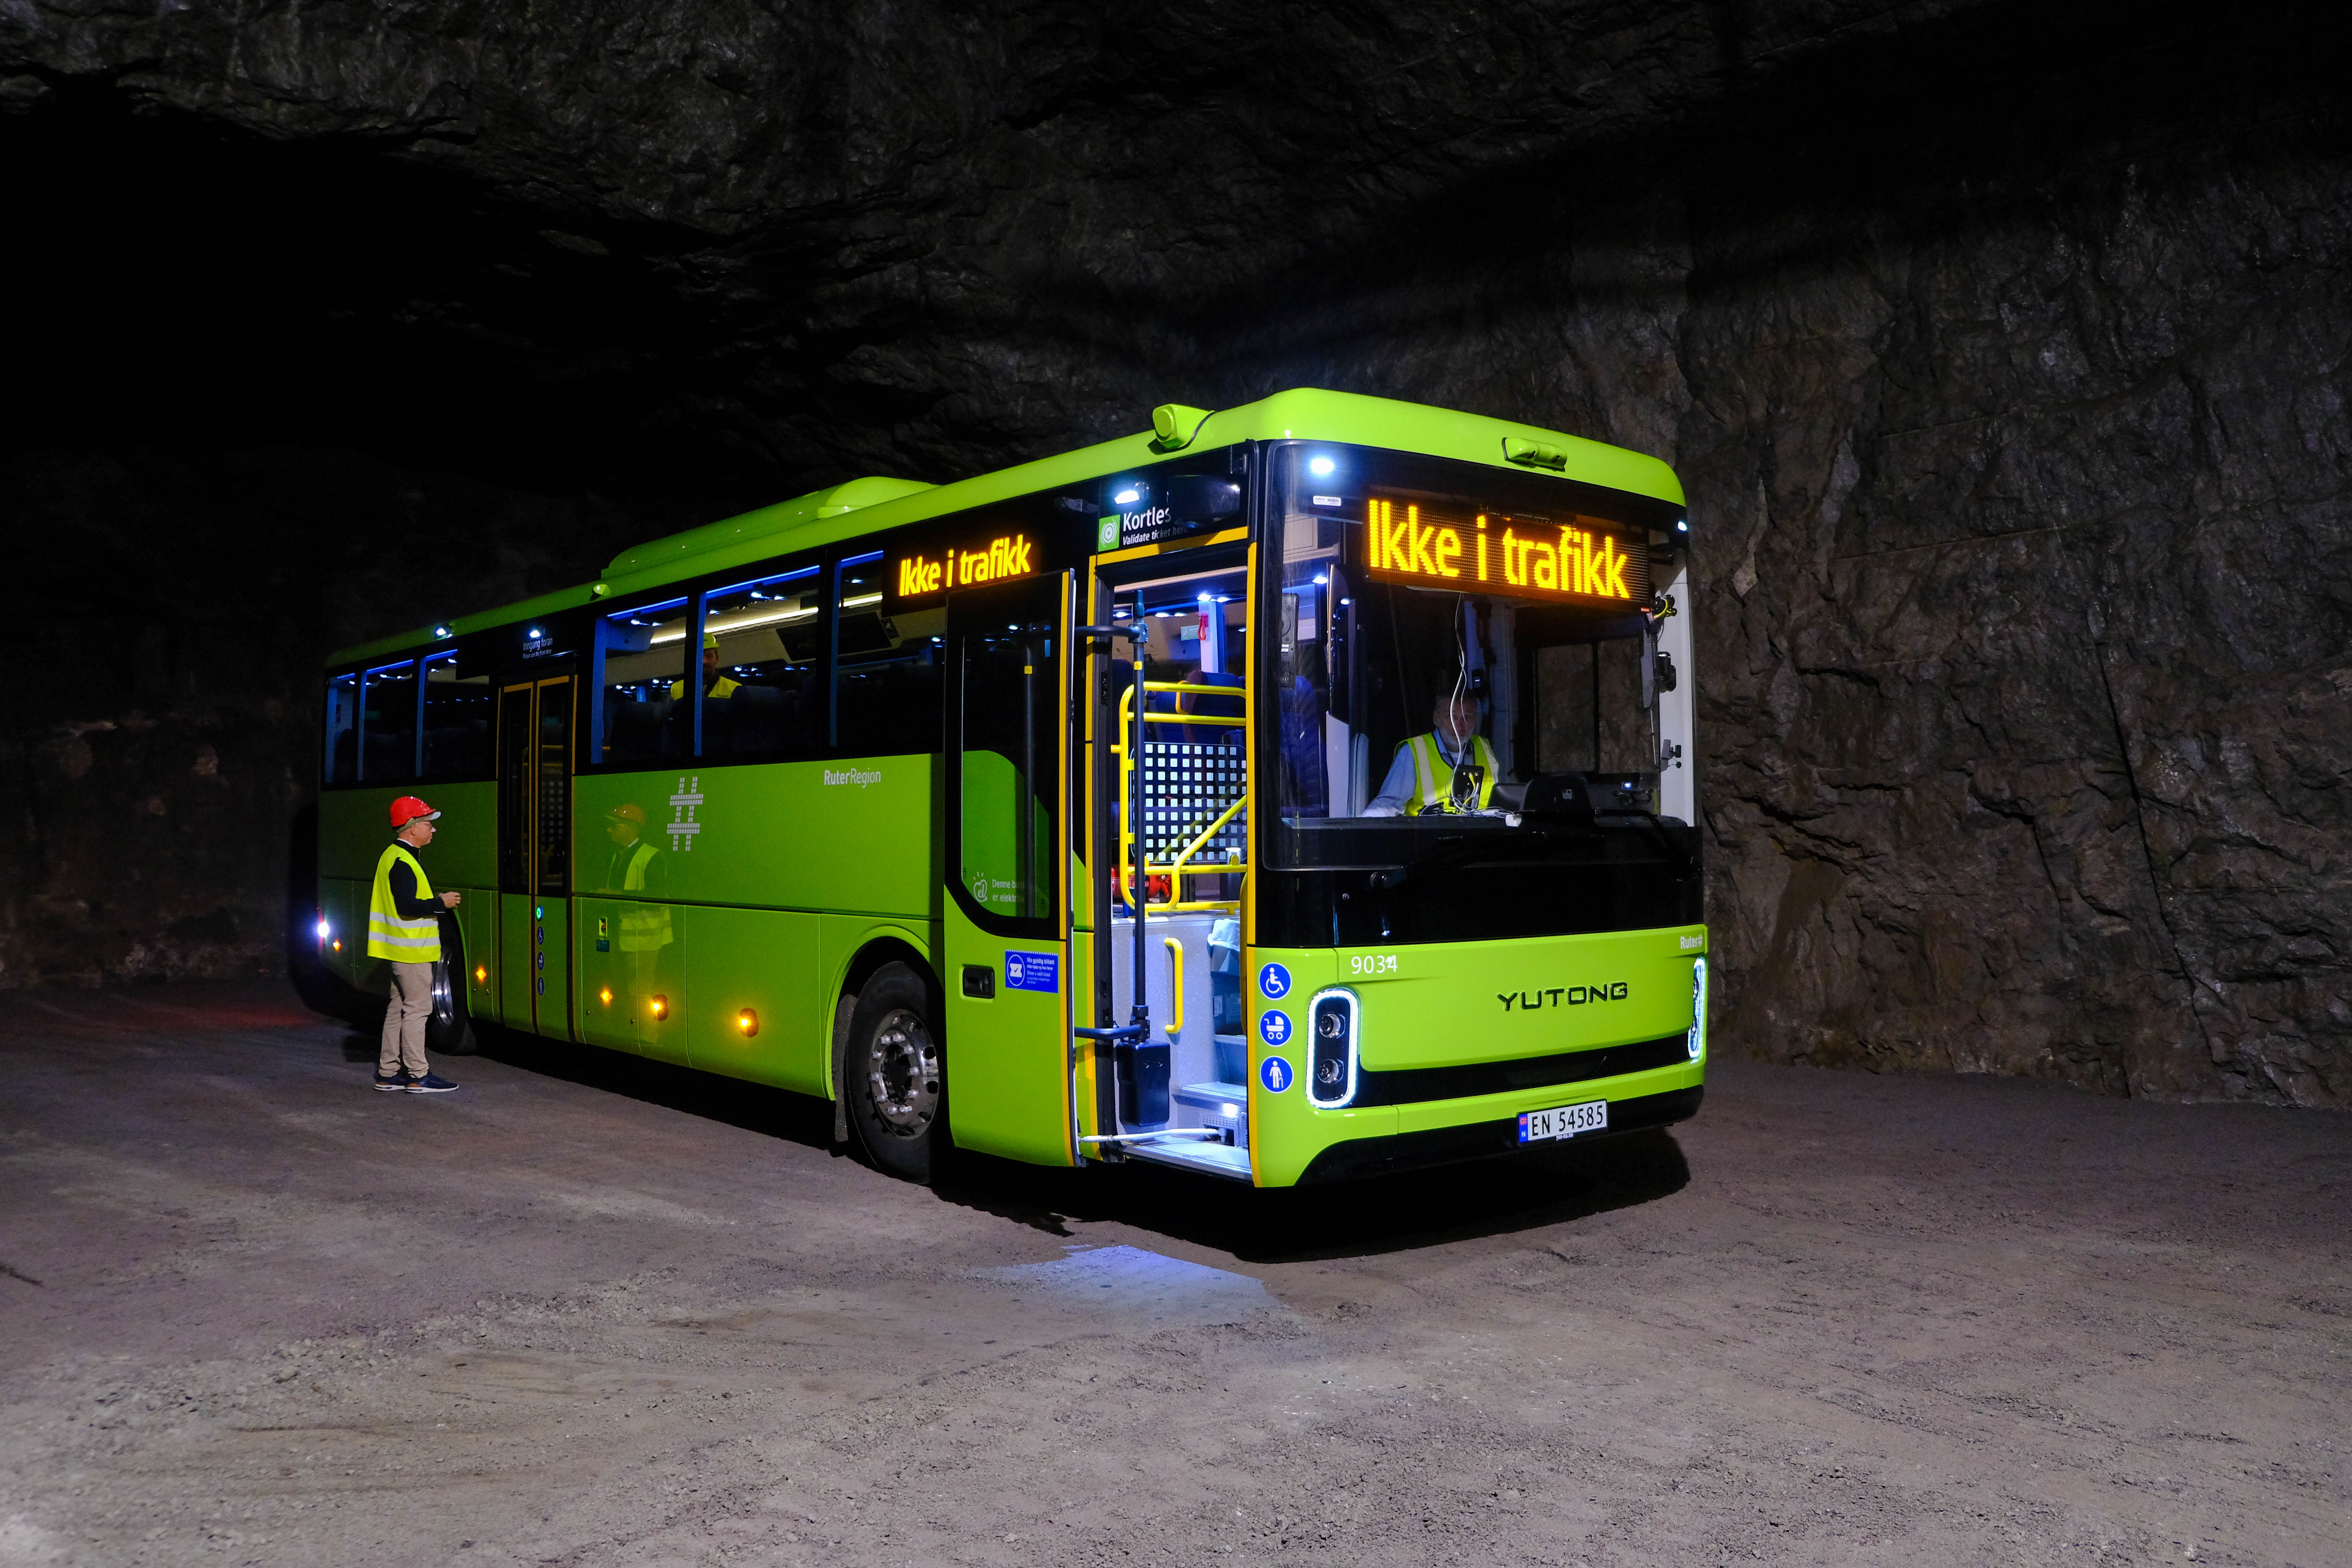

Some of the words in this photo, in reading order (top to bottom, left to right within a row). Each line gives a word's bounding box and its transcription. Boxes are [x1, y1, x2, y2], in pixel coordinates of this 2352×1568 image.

[1123, 507, 1171, 532] Kortles
[1123, 533, 1150, 546] Validate
[1152, 528, 1171, 540] ticket
[1369, 500, 1461, 577] Ikke
[1477, 515, 1487, 581] i
[1503, 525, 1630, 599] trafikk
[899, 556, 941, 596] Ikke
[946, 549, 954, 587] i
[960, 534, 1031, 584] trafikk
[523, 642, 541, 652] Inngang
[541, 638, 553, 647] foran
[824, 767, 881, 788] RuterRegion
[992, 879, 1011, 888] Denne
[1351, 955, 1398, 974] 9034
[1496, 980, 1628, 1012] YUTONG
[1531, 1113, 1550, 1136] EN
[1559, 1105, 1603, 1132] 54585
